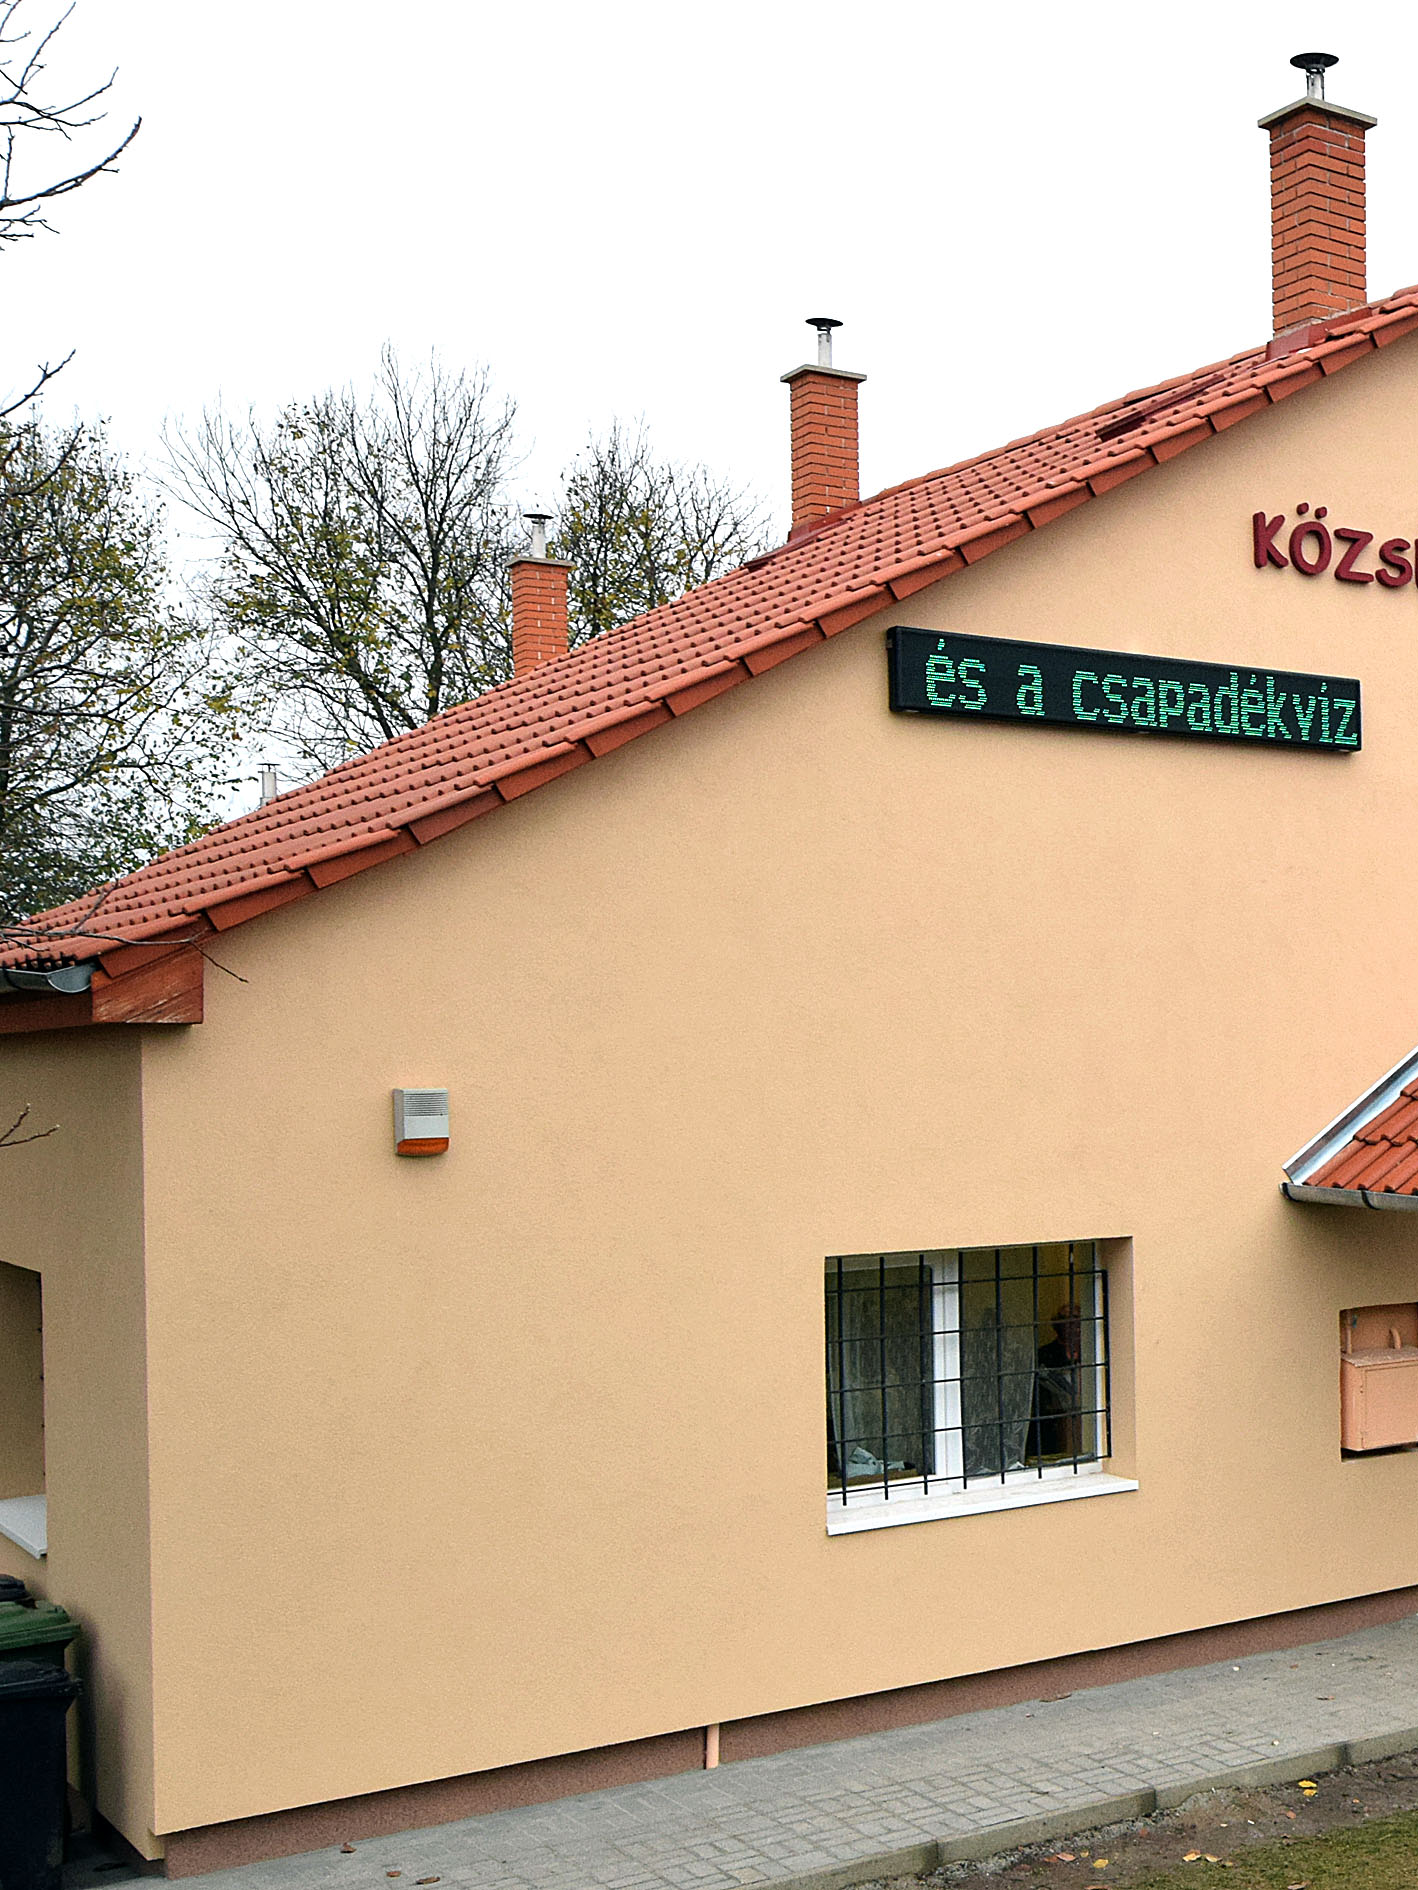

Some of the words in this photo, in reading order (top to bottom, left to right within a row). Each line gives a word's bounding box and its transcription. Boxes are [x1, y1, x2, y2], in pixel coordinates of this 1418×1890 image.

[925, 638, 989, 711] és
[1016, 664, 1046, 716] a
[1071, 671, 1358, 746] csapadékvíz
